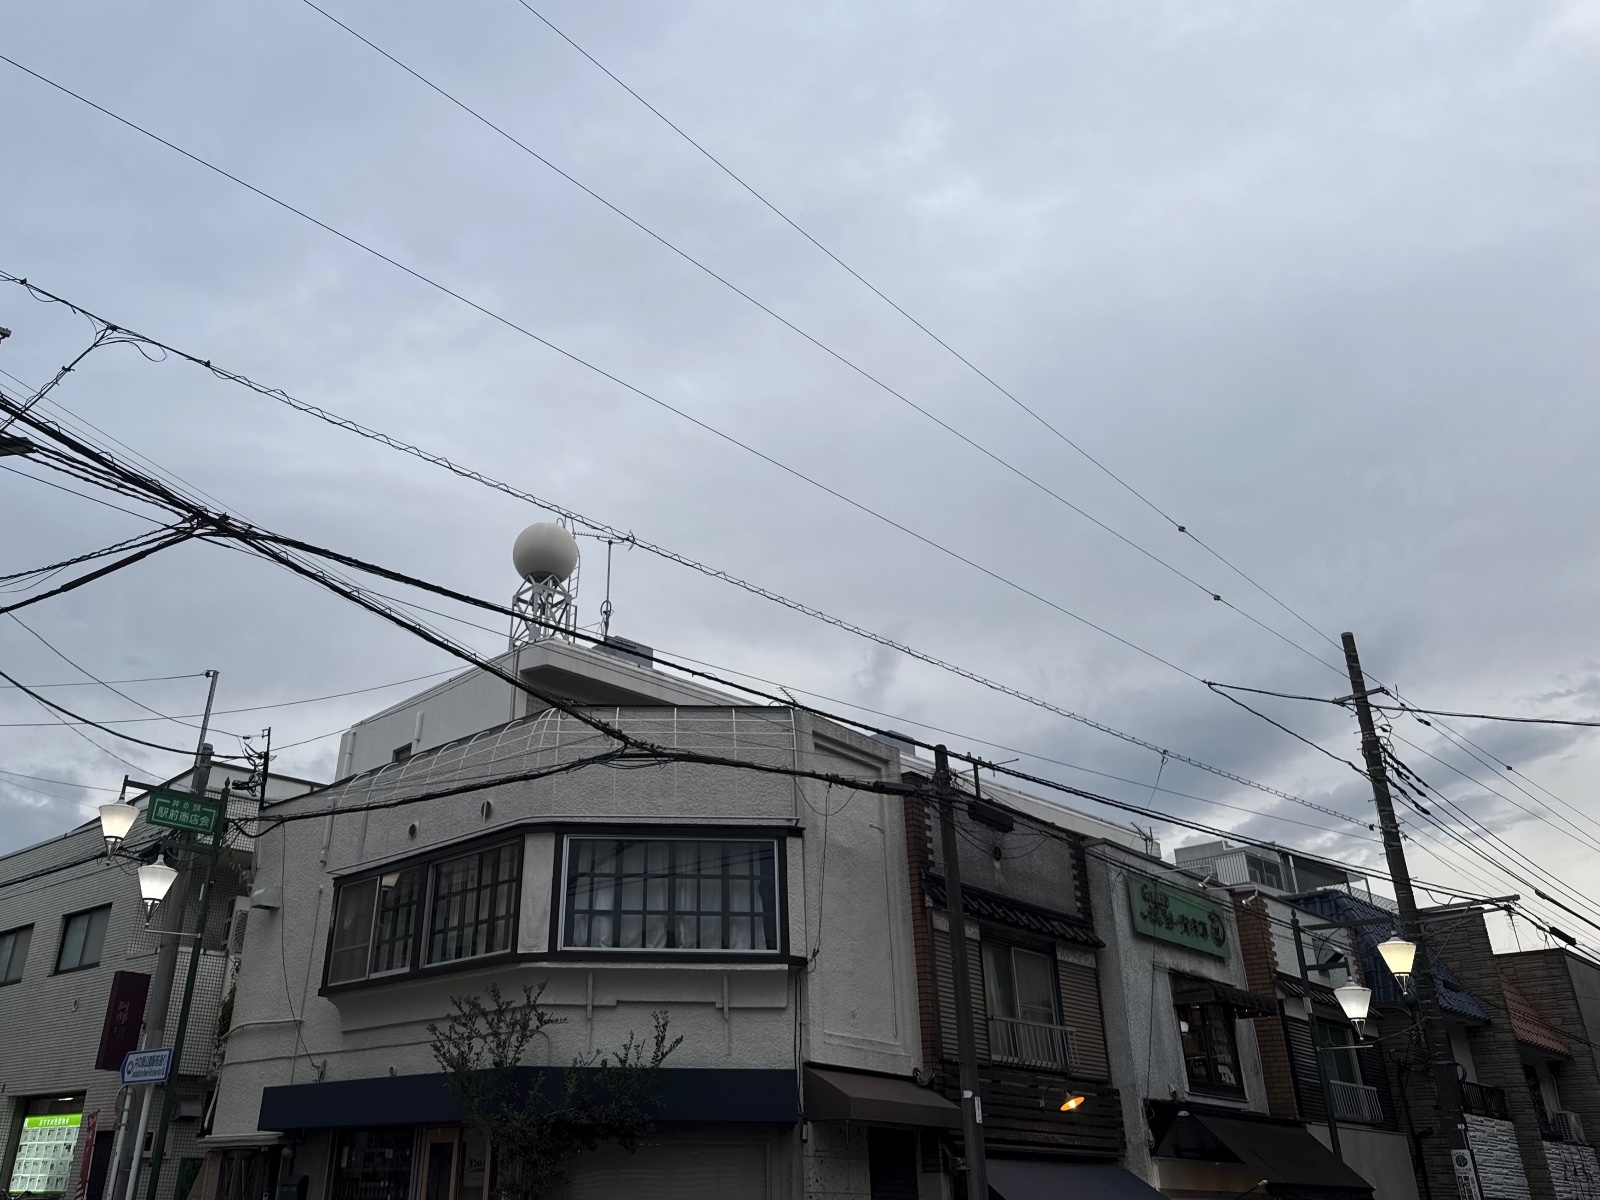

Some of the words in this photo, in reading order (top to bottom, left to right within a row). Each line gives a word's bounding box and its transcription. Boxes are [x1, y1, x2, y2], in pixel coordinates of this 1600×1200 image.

[172, 800, 201, 811] 井の頭
[156, 806, 210, 827] 駅前商店会
